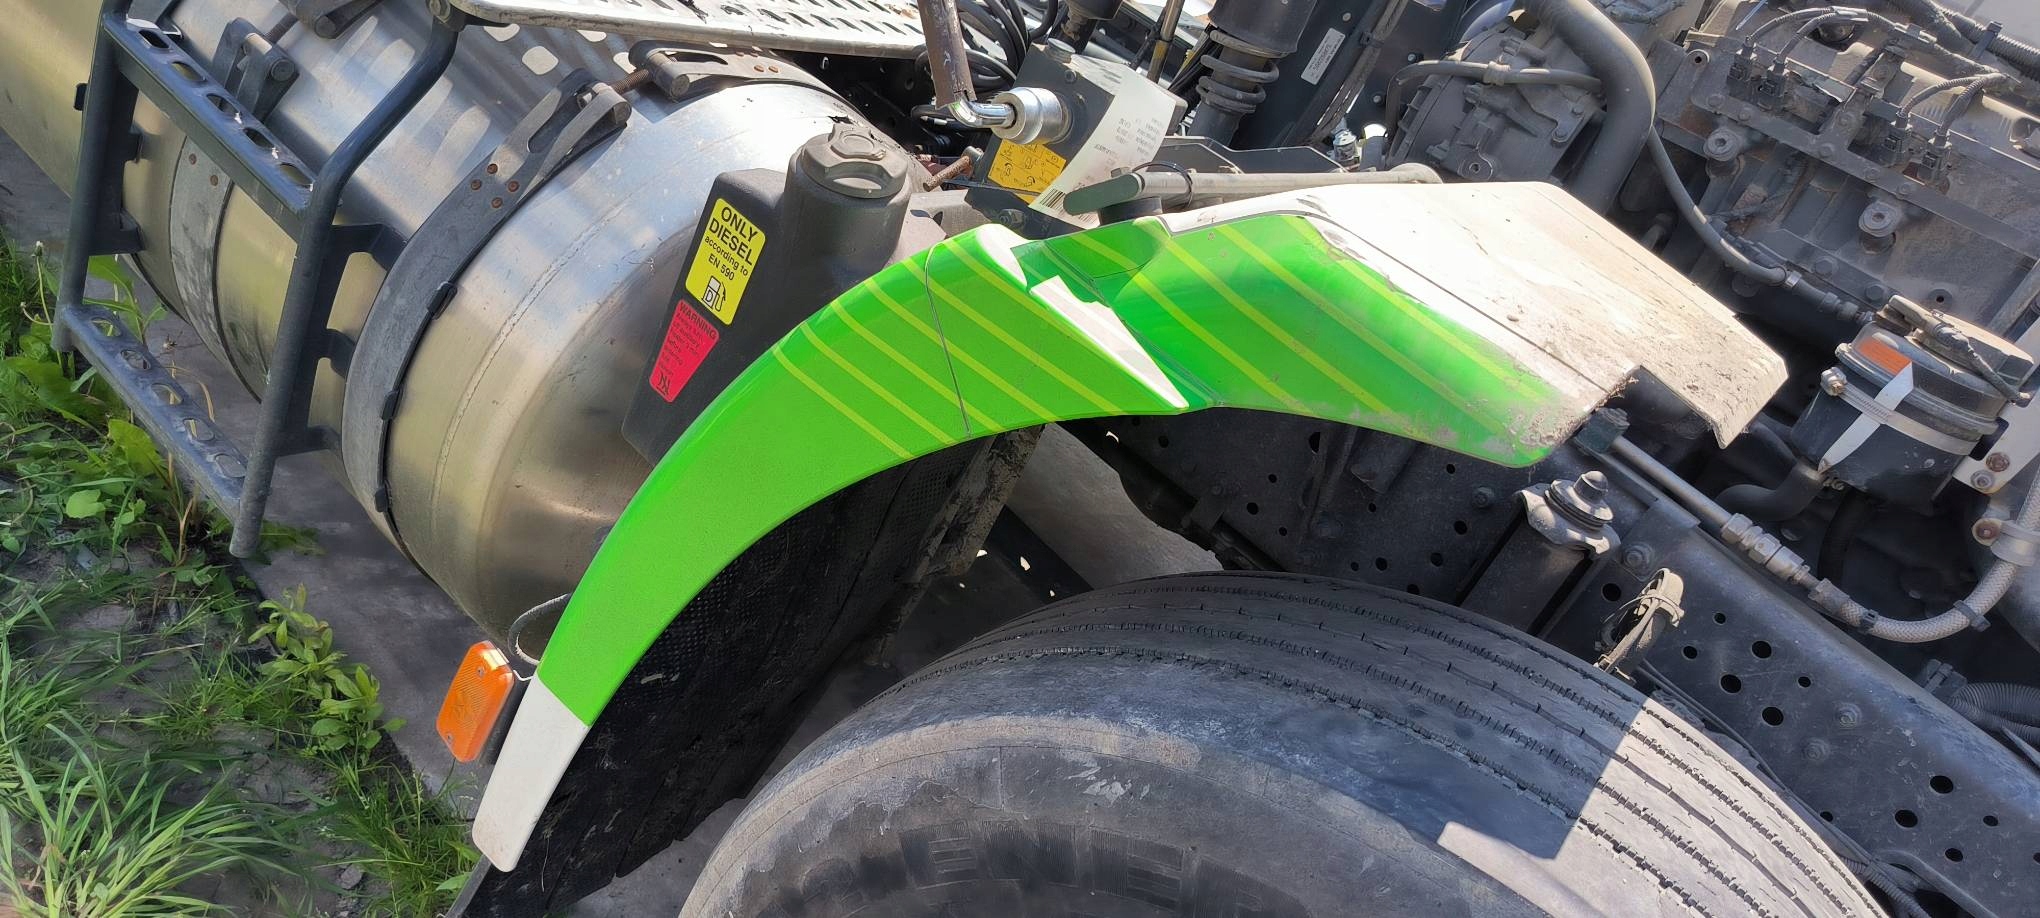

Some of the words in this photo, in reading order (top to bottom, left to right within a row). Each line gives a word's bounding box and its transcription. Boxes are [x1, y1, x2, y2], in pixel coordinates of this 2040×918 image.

[709, 218, 753, 266] DIESEL
[721, 207, 758, 242] ONLY
[705, 236, 740, 270] according
[739, 265, 749, 276] to
[708, 253, 720, 269] EN
[720, 264, 735, 281] 590
[706, 290, 714, 302] D
[680, 302, 717, 339] WARNING
